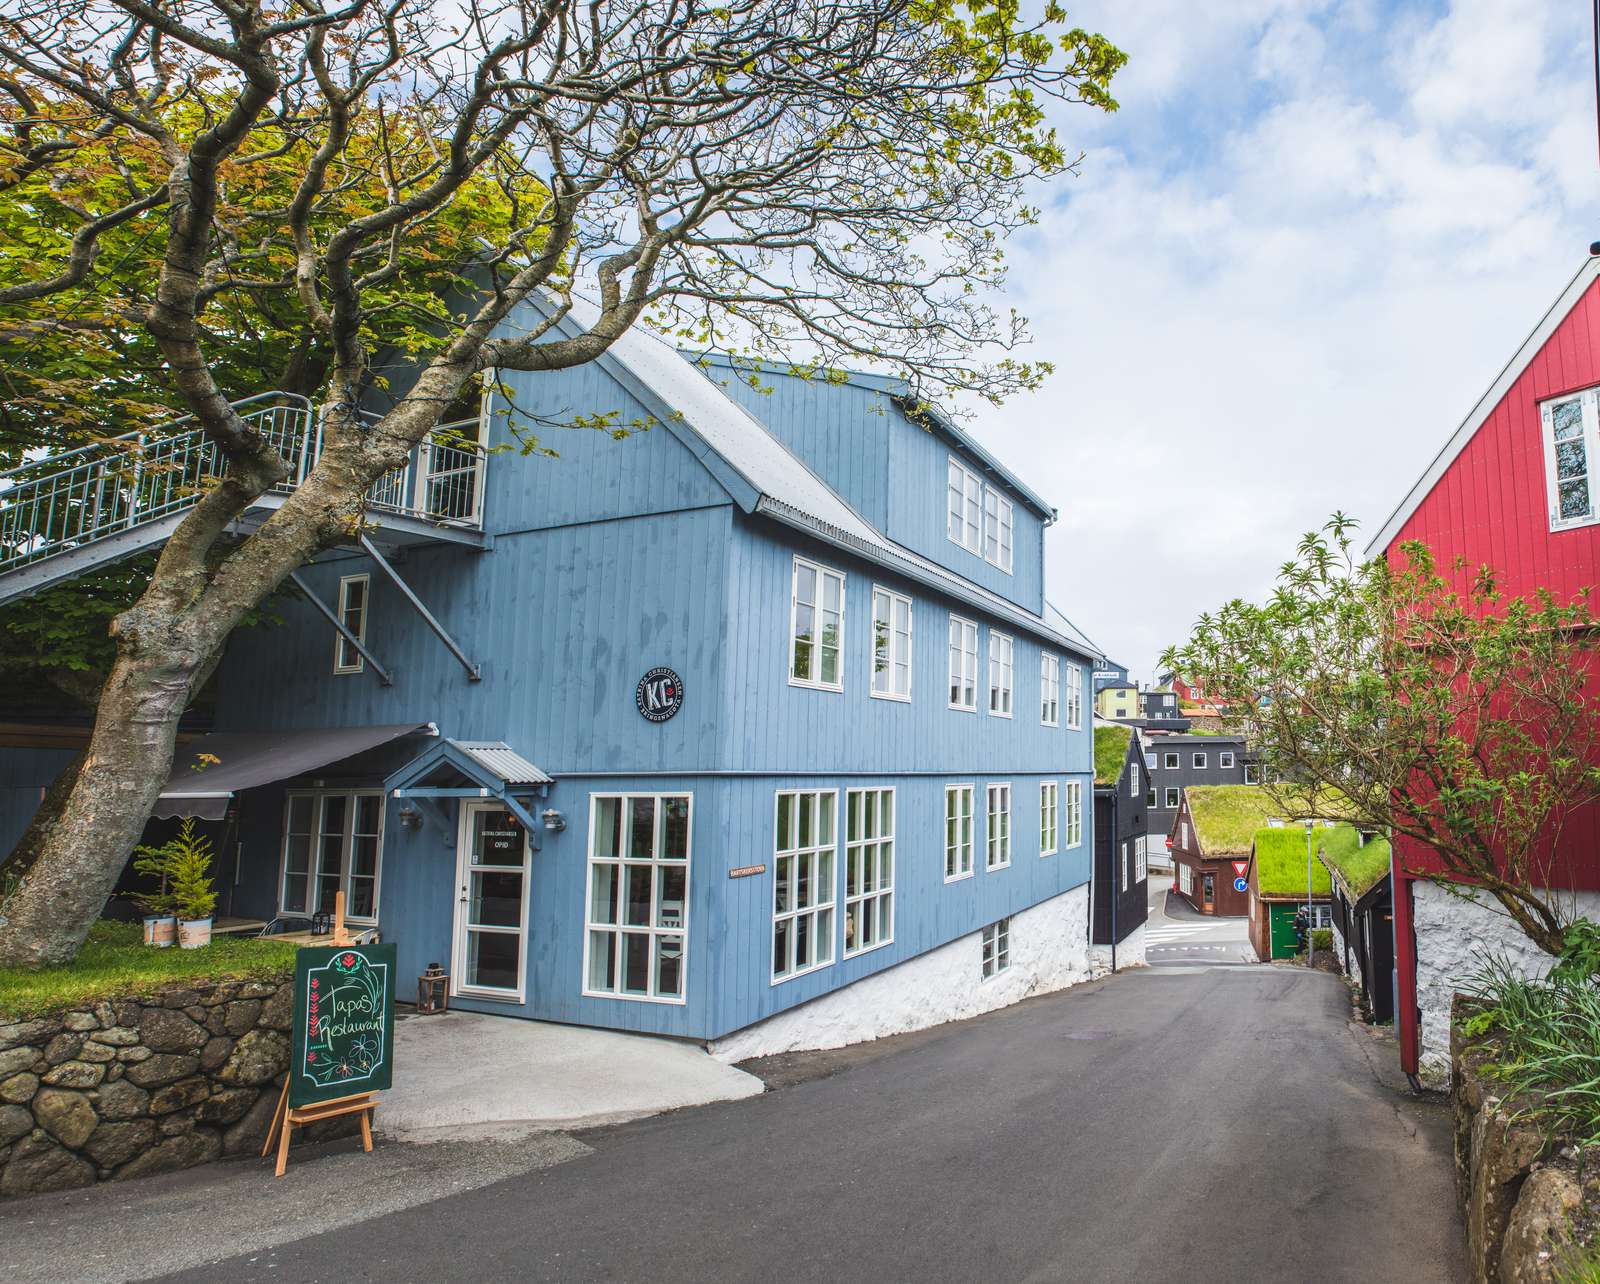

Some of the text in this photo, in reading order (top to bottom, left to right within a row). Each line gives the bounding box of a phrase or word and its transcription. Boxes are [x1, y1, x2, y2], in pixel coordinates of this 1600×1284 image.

[646, 678, 673, 710] KC
[318, 984, 374, 1020] Tapas
[315, 1010, 385, 1052] Restaurant
